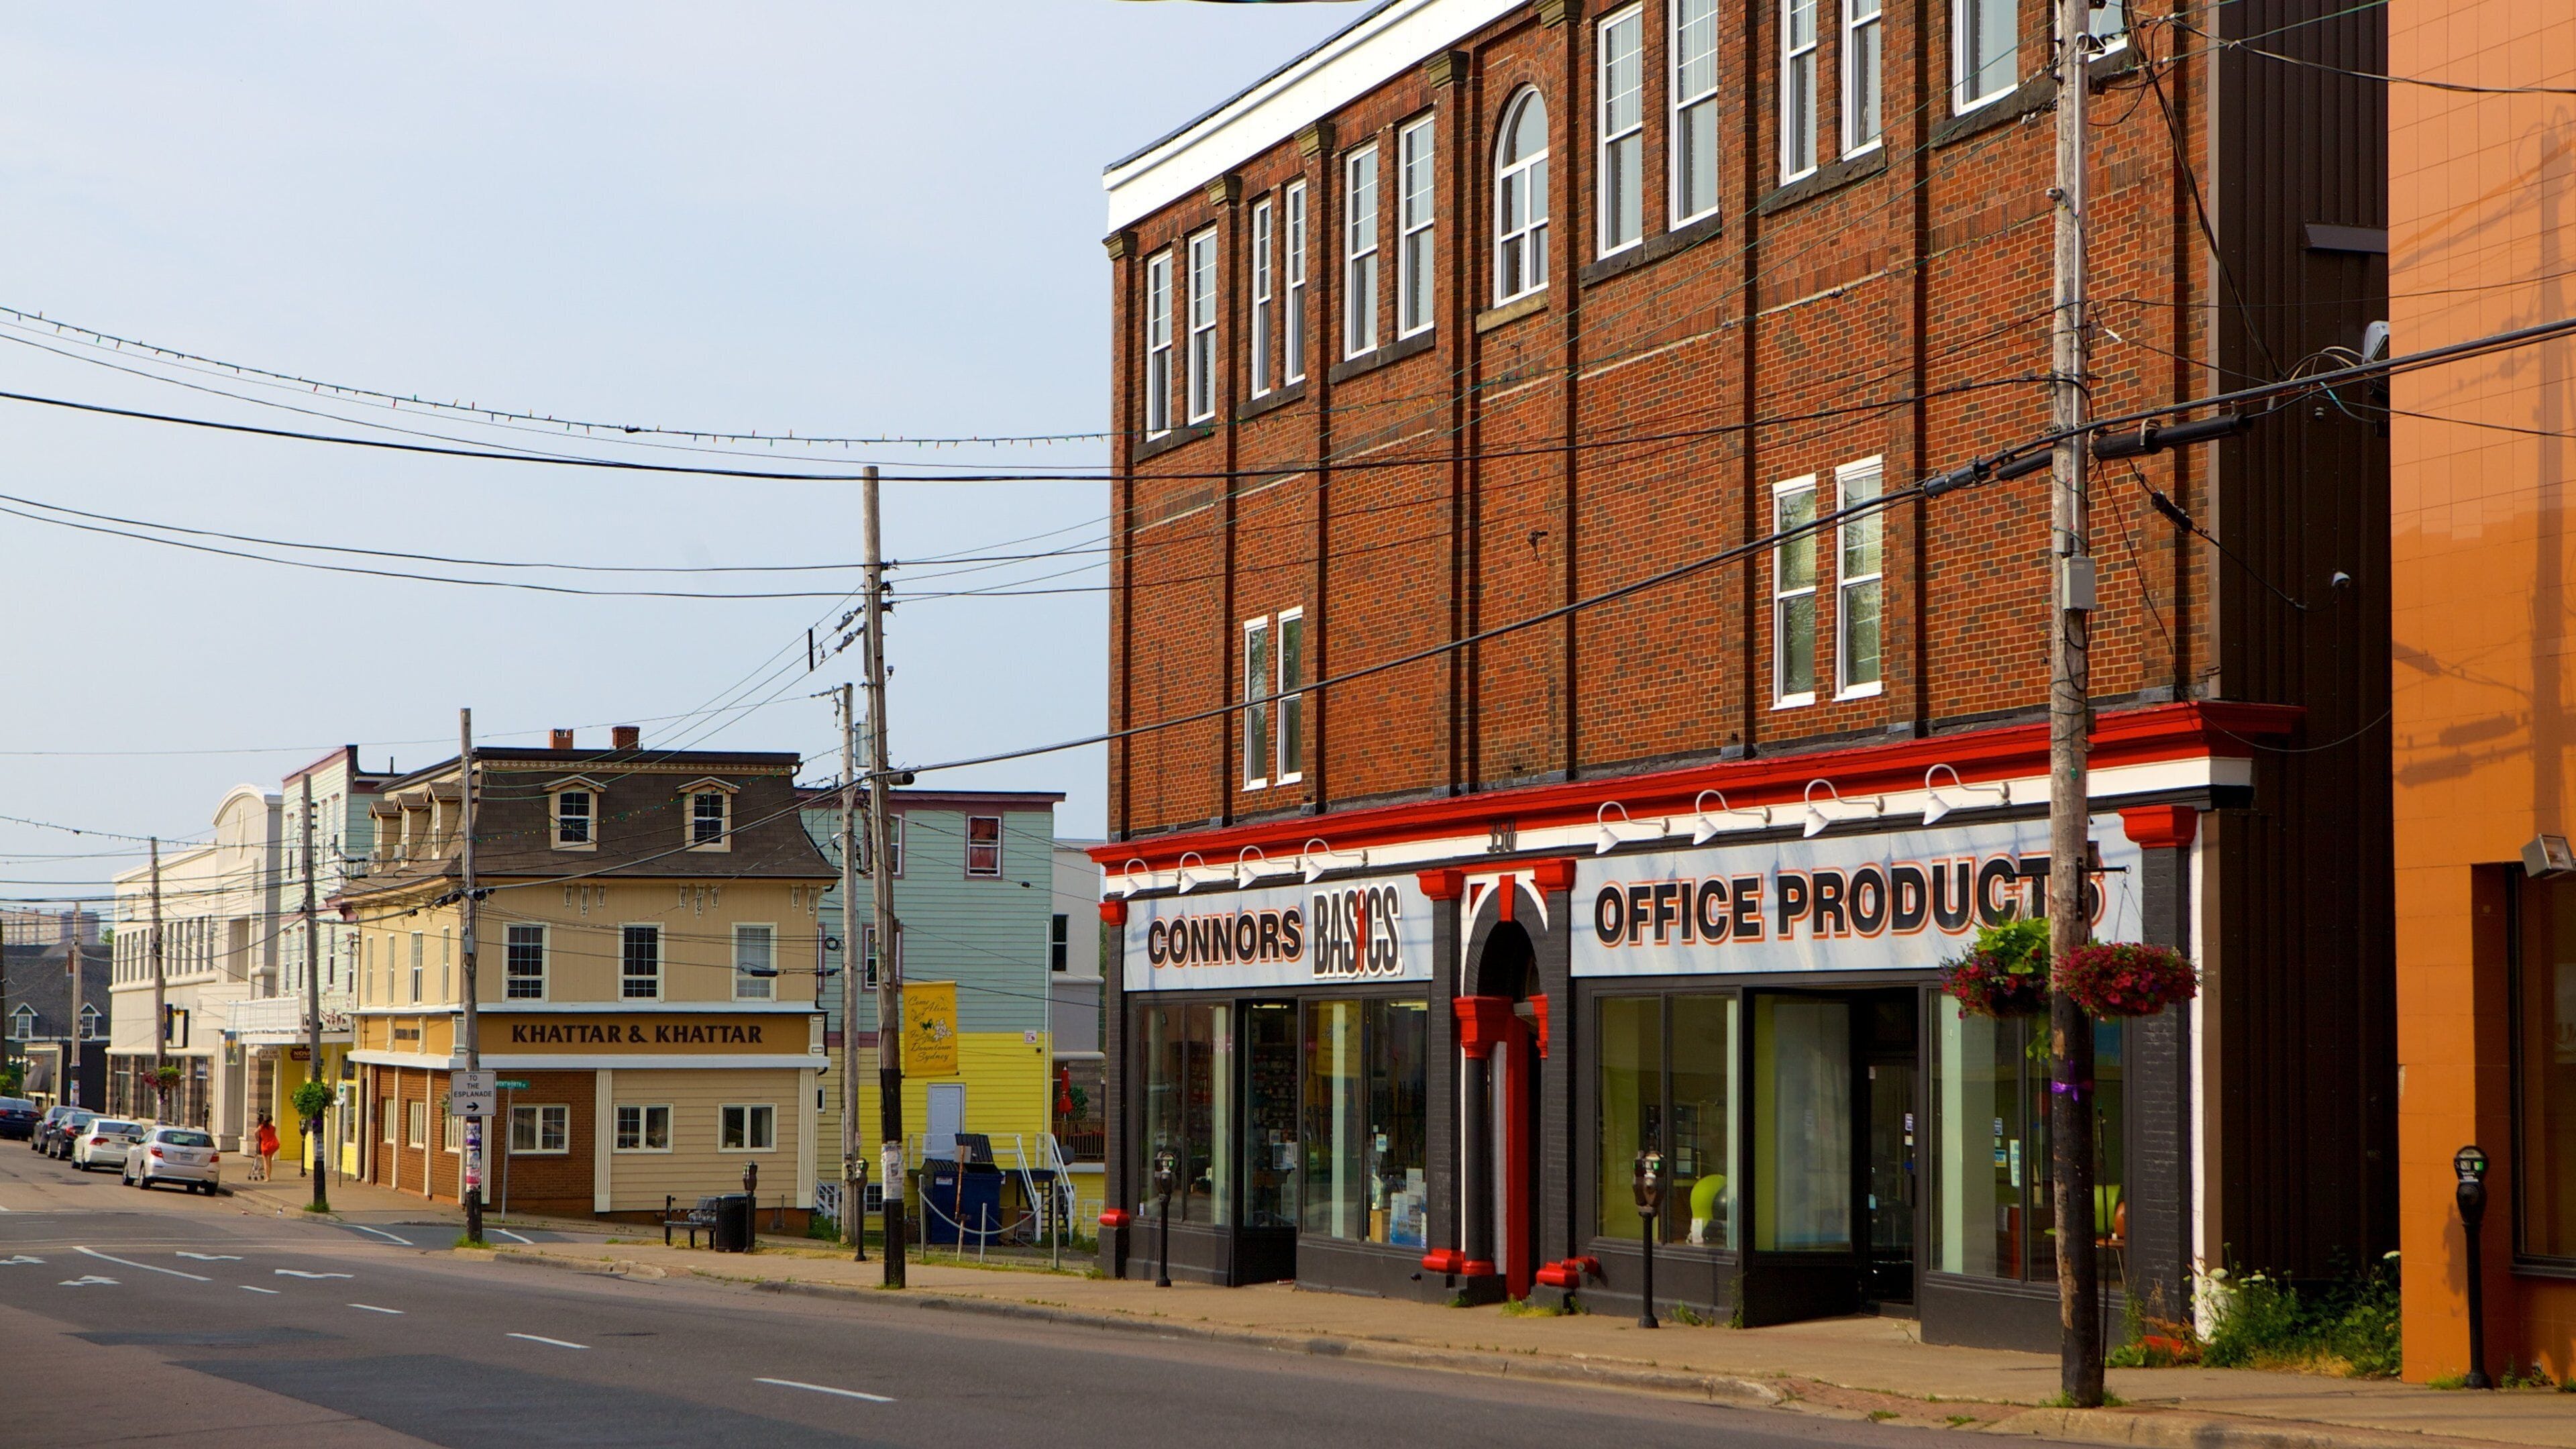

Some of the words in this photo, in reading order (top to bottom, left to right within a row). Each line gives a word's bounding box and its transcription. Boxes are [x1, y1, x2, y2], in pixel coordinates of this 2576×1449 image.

[1595, 873, 1766, 947] OFFICE
[1776, 851, 2106, 941] PRODUCT
[1148, 906, 1305, 969] CONNORS
[1311, 881, 1402, 979] BASICS
[908, 996, 930, 1006] Come
[511, 1024, 623, 1043] KHATTAR
[628, 1024, 649, 1043] &
[655, 1024, 763, 1043] KHATTAR
[910, 1042, 953, 1052] Downtown
[916, 1052, 950, 1063] Sydney
